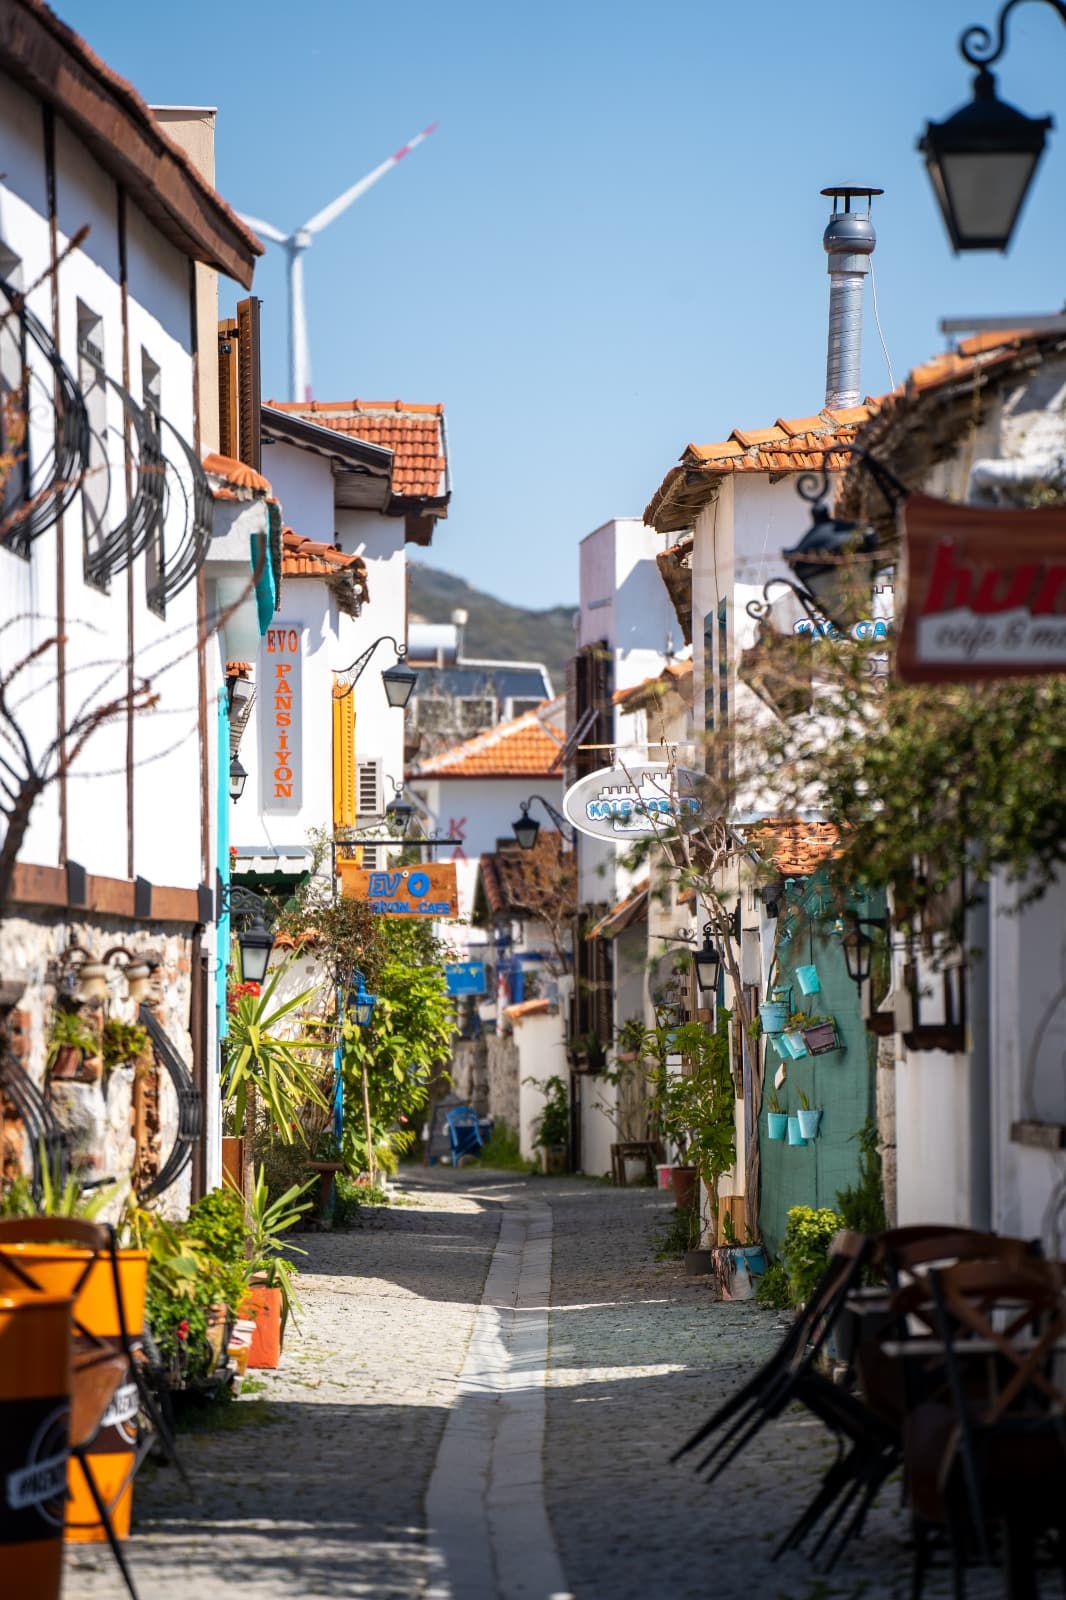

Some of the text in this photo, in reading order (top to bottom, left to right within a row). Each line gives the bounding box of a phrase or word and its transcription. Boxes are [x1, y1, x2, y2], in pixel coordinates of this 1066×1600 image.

[267, 630, 298, 653] EVO
[274, 664, 293, 798] PANSİYON
[418, 901, 449, 914] CAFE
